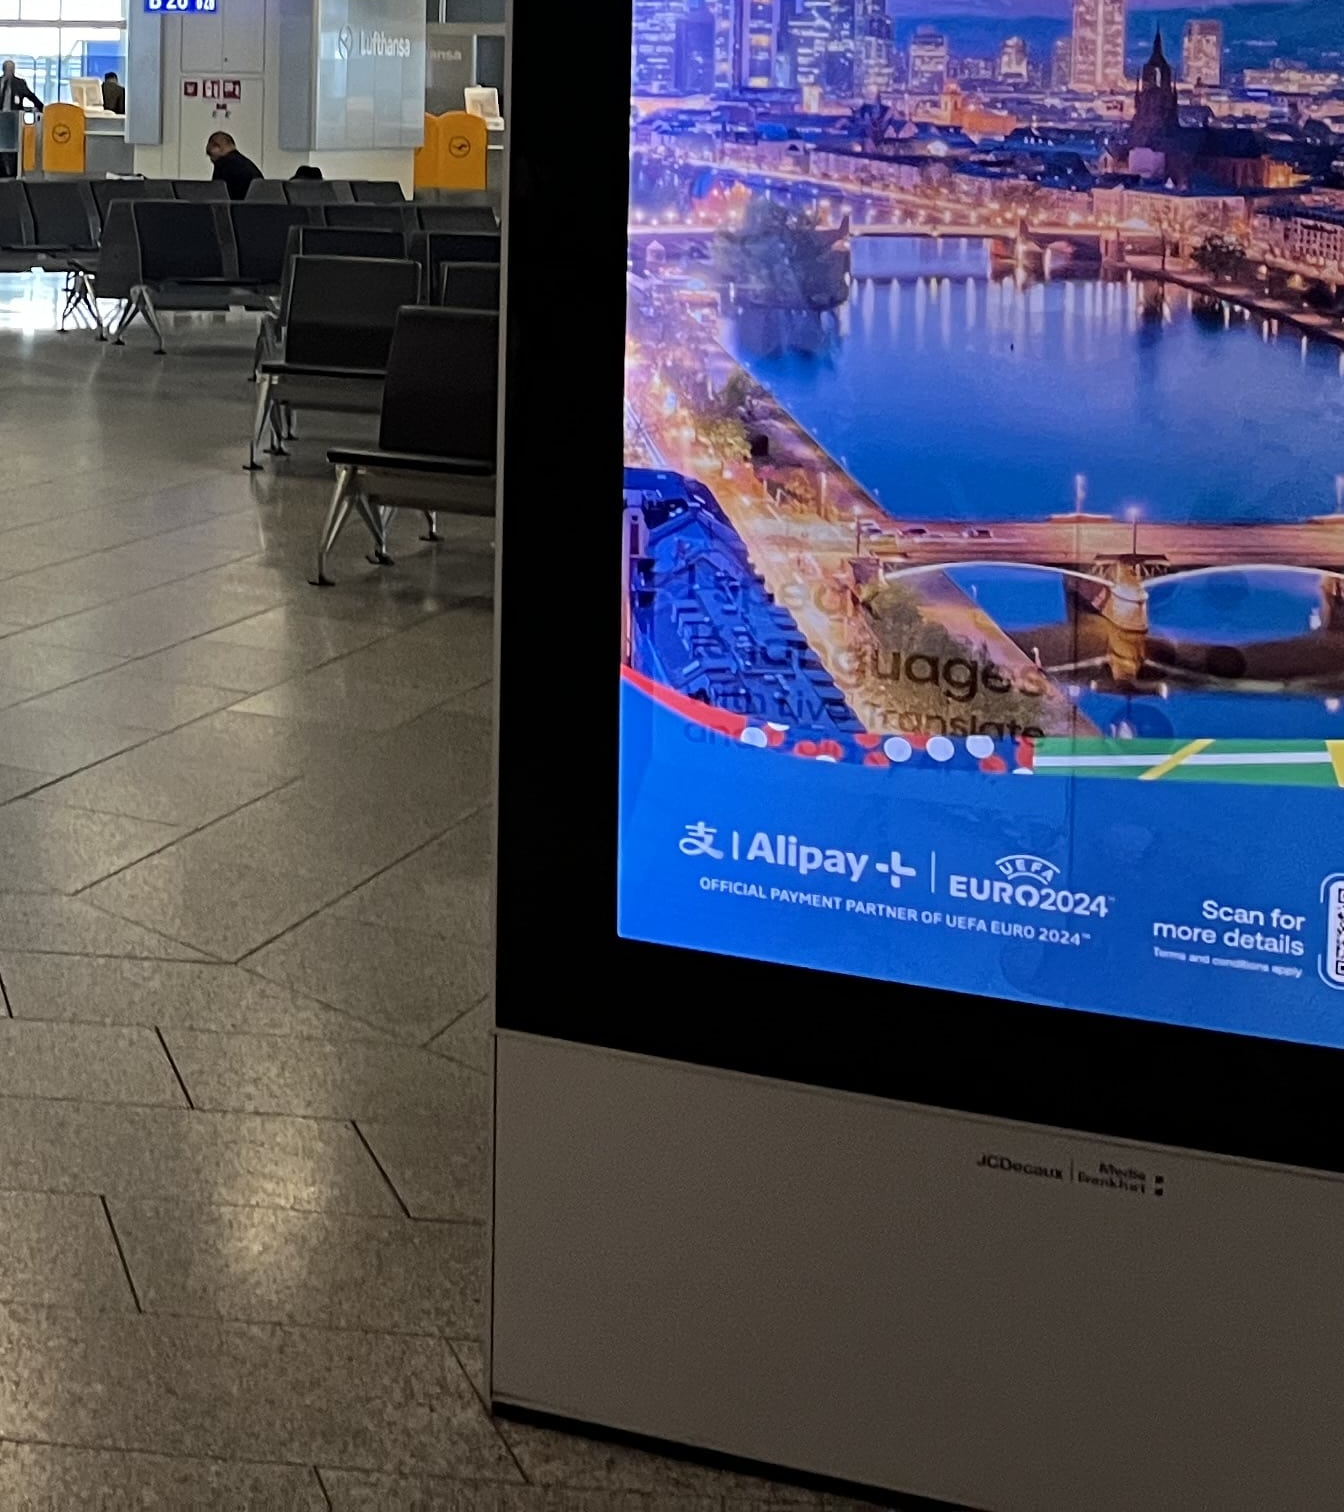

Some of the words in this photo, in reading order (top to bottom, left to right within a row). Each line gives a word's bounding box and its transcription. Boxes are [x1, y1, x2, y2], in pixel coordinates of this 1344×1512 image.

[360, 30, 411, 58] Lufthansa
[998, 859, 1054, 882] UEFA
[699, 877, 767, 899] OFFICIAL
[770, 888, 843, 911] PAYMENT
[846, 899, 918, 922] PARTNER
[921, 910, 942, 925] OF
[945, 913, 987, 932] UEFA
[990, 920, 1035, 939] EURO
[1202, 899, 1265, 926] Scan
[1270, 908, 1306, 931] for
[1153, 922, 1217, 944] more
[1223, 928, 1305, 956] details
[976, 1154, 1063, 1180] JCDecaux
